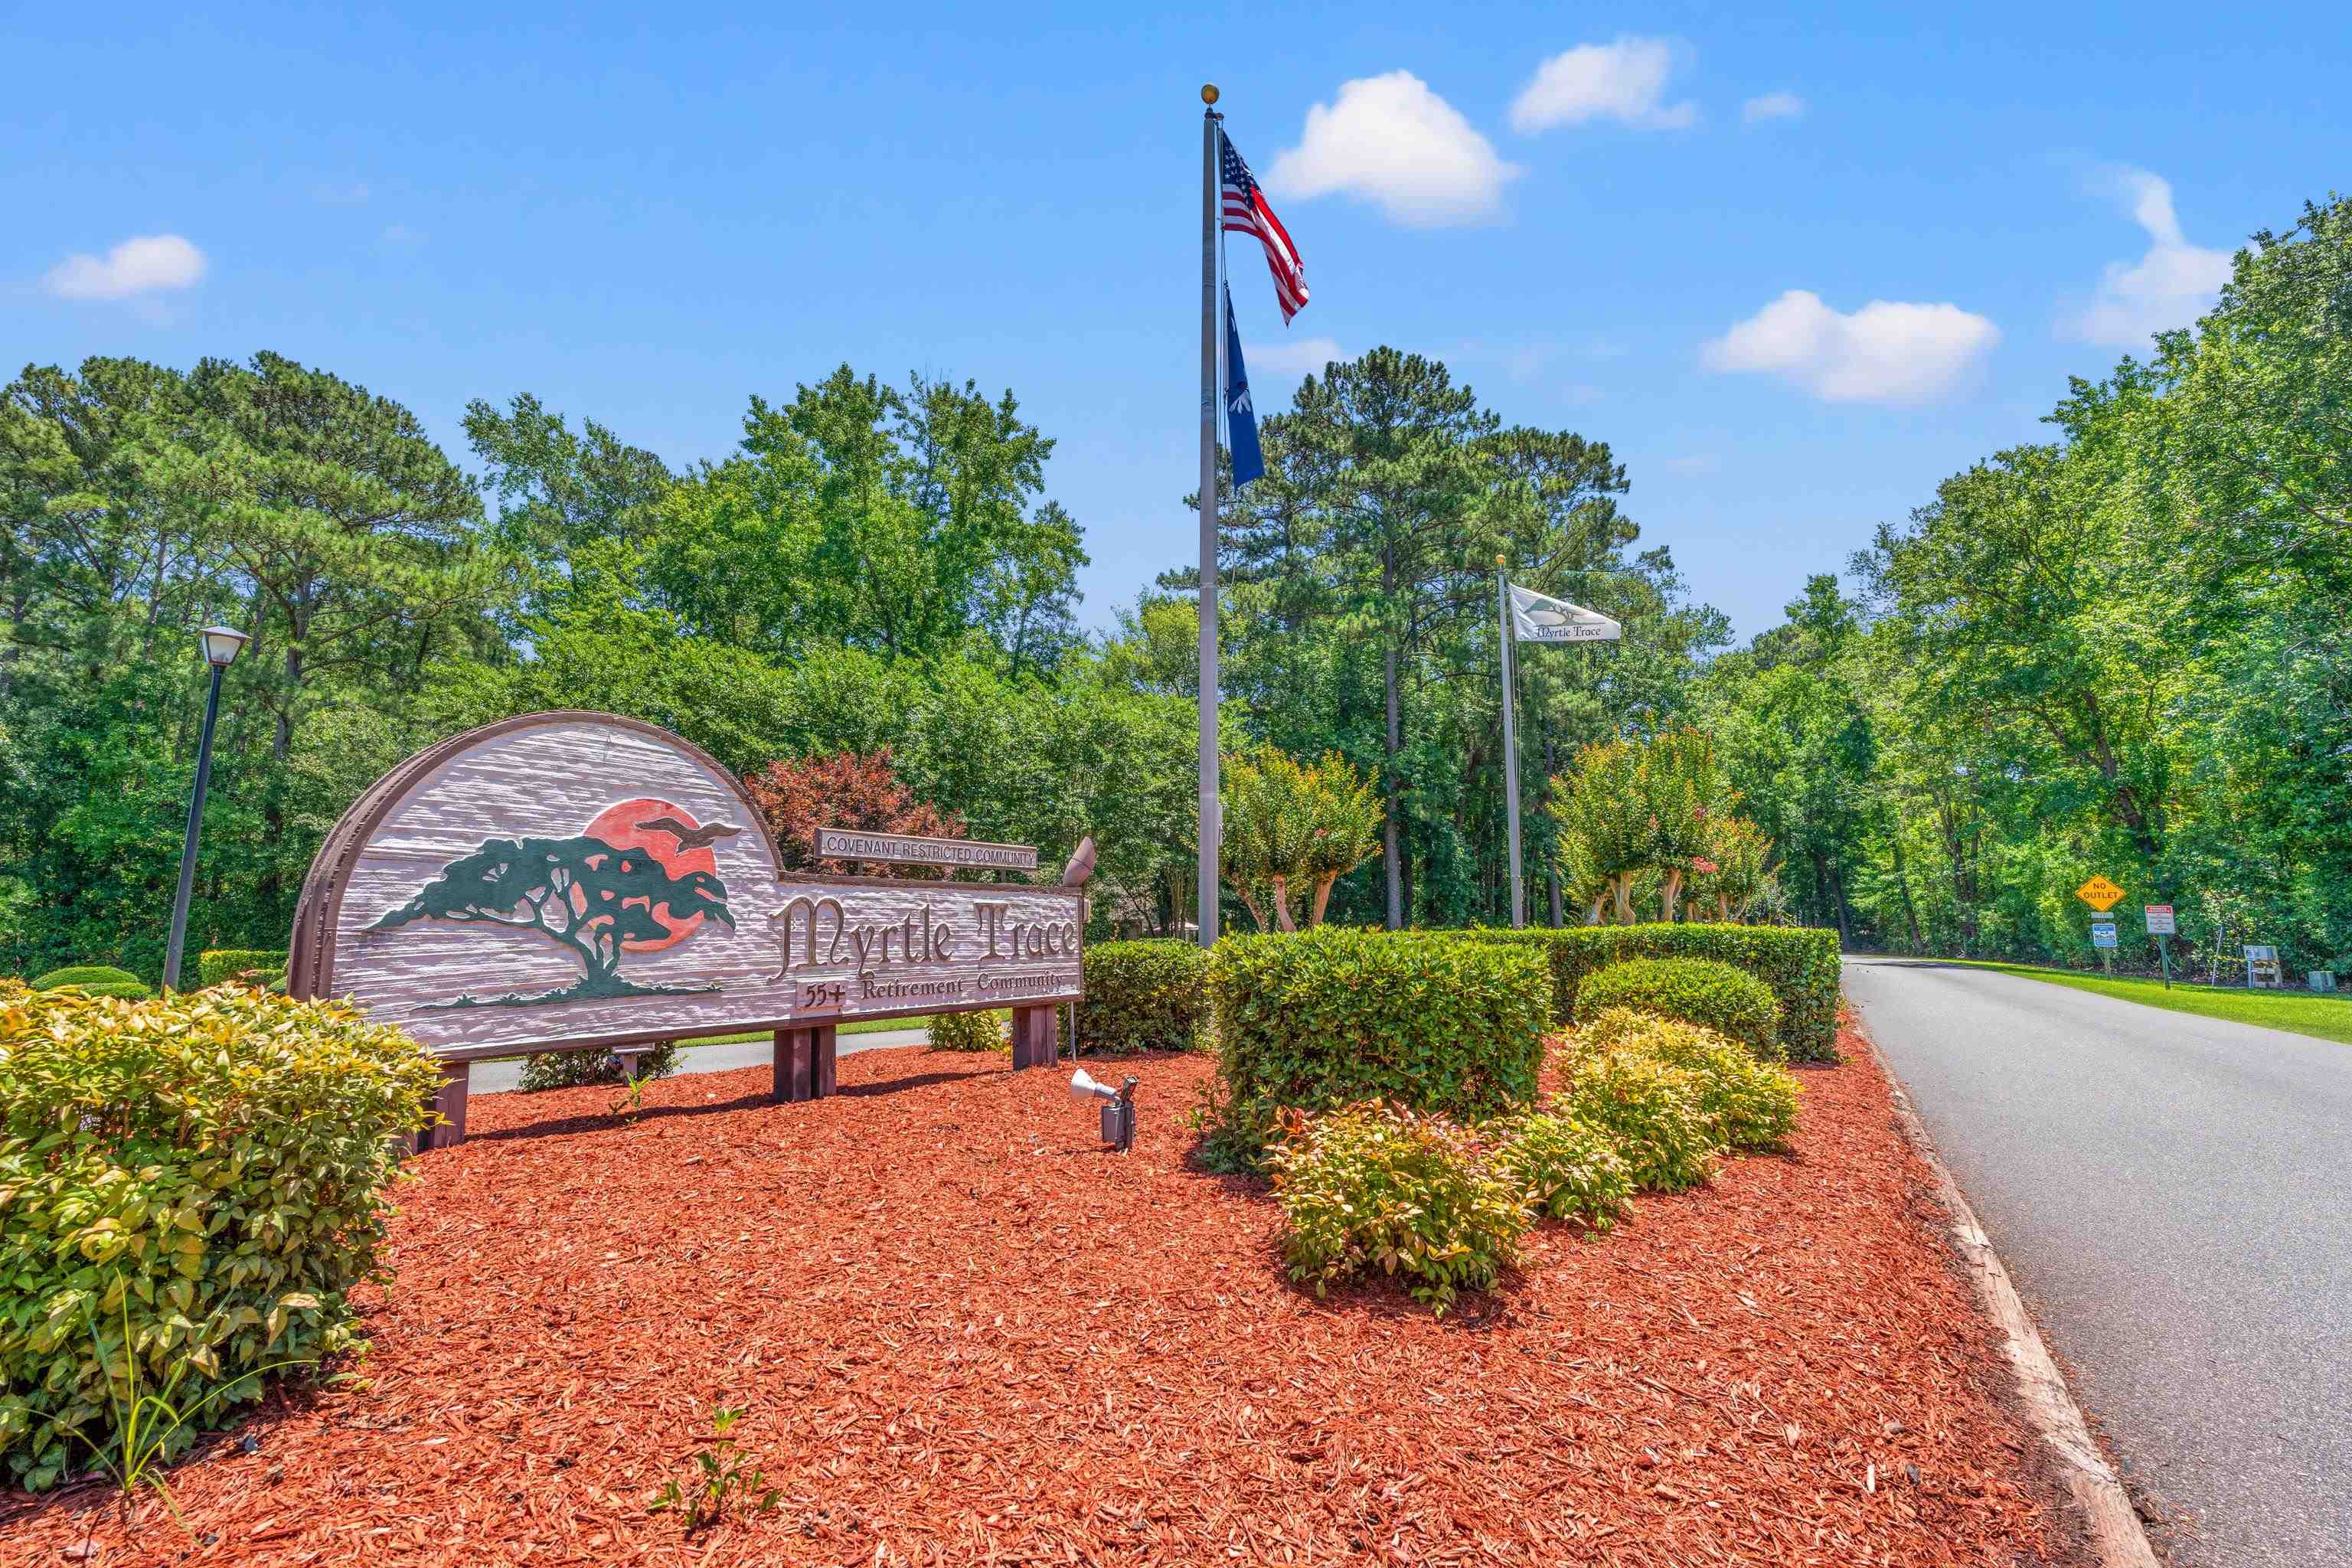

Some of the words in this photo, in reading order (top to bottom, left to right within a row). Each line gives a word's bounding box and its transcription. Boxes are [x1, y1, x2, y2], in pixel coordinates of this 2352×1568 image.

[1537, 626, 1570, 638] Myrtle
[1573, 626, 1601, 637] Trace
[827, 836, 897, 855] COVENANT
[903, 842, 972, 862] RESTRICTED
[975, 848, 1035, 866] COMMUNITY
[767, 897, 952, 982] Myrtle
[975, 903, 1074, 962] Trace
[805, 983, 846, 1008] 55+
[861, 980, 964, 1000] Retirement
[978, 971, 1063, 991] Community
